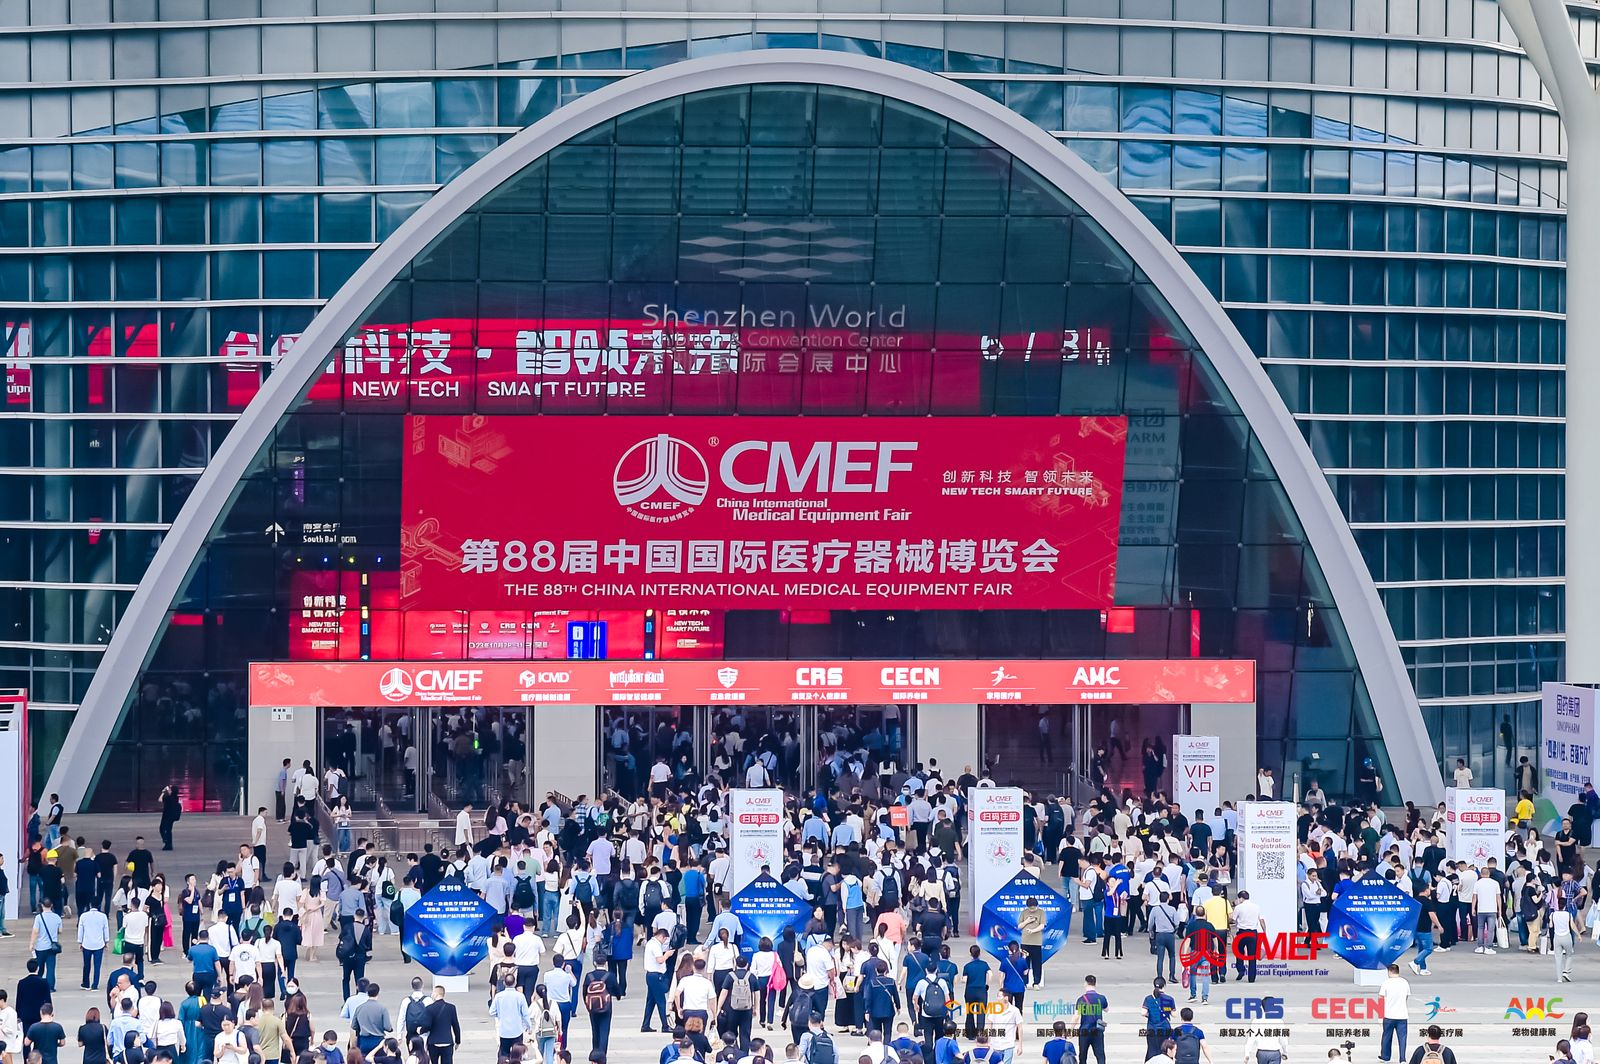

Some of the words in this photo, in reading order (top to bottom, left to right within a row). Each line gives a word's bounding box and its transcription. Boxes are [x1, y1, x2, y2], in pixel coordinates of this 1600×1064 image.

[641, 304, 796, 328] Shenzhen
[810, 303, 906, 328] World
[747, 331, 843, 347] Convention
[848, 332, 904, 347] Center
[352, 380, 400, 396] NEW
[719, 440, 919, 494] CMEF
[941, 470, 1012, 484] 创新科技
[1024, 470, 1094, 484] 智领未来
[941, 487, 968, 496] NEW
[971, 487, 1001, 496] TECH
[1004, 487, 1044, 496] SMART
[1047, 487, 1093, 496] FUTURE
[640, 501, 681, 510] CMEF
[716, 498, 749, 509] China
[752, 498, 828, 509] International
[732, 508, 795, 522] Medical
[799, 508, 880, 524] Equipment
[884, 508, 912, 521] Fair
[303, 534, 324, 543] South
[324, 534, 357, 543] Baloom
[460, 538, 1060, 575] 第88届中国国际医疗器械博览会
[504, 583, 539, 596] THE
[543, 583, 577, 596] 88TH
[581, 583, 636, 597] CHINA
[640, 583, 779, 597] INTERNATIONAL
[784, 583, 861, 596] MEDICAL
[866, 583, 970, 596] EQUIPMENT
[973, 583, 1013, 596] FAIR
[415, 669, 484, 691] CMEF
[538, 672, 570, 683] ICMD
[795, 667, 843, 686] CRS
[880, 667, 940, 686] CECN
[1184, 764, 1215, 778] VIP
[1186, 781, 1212, 793] 入口
